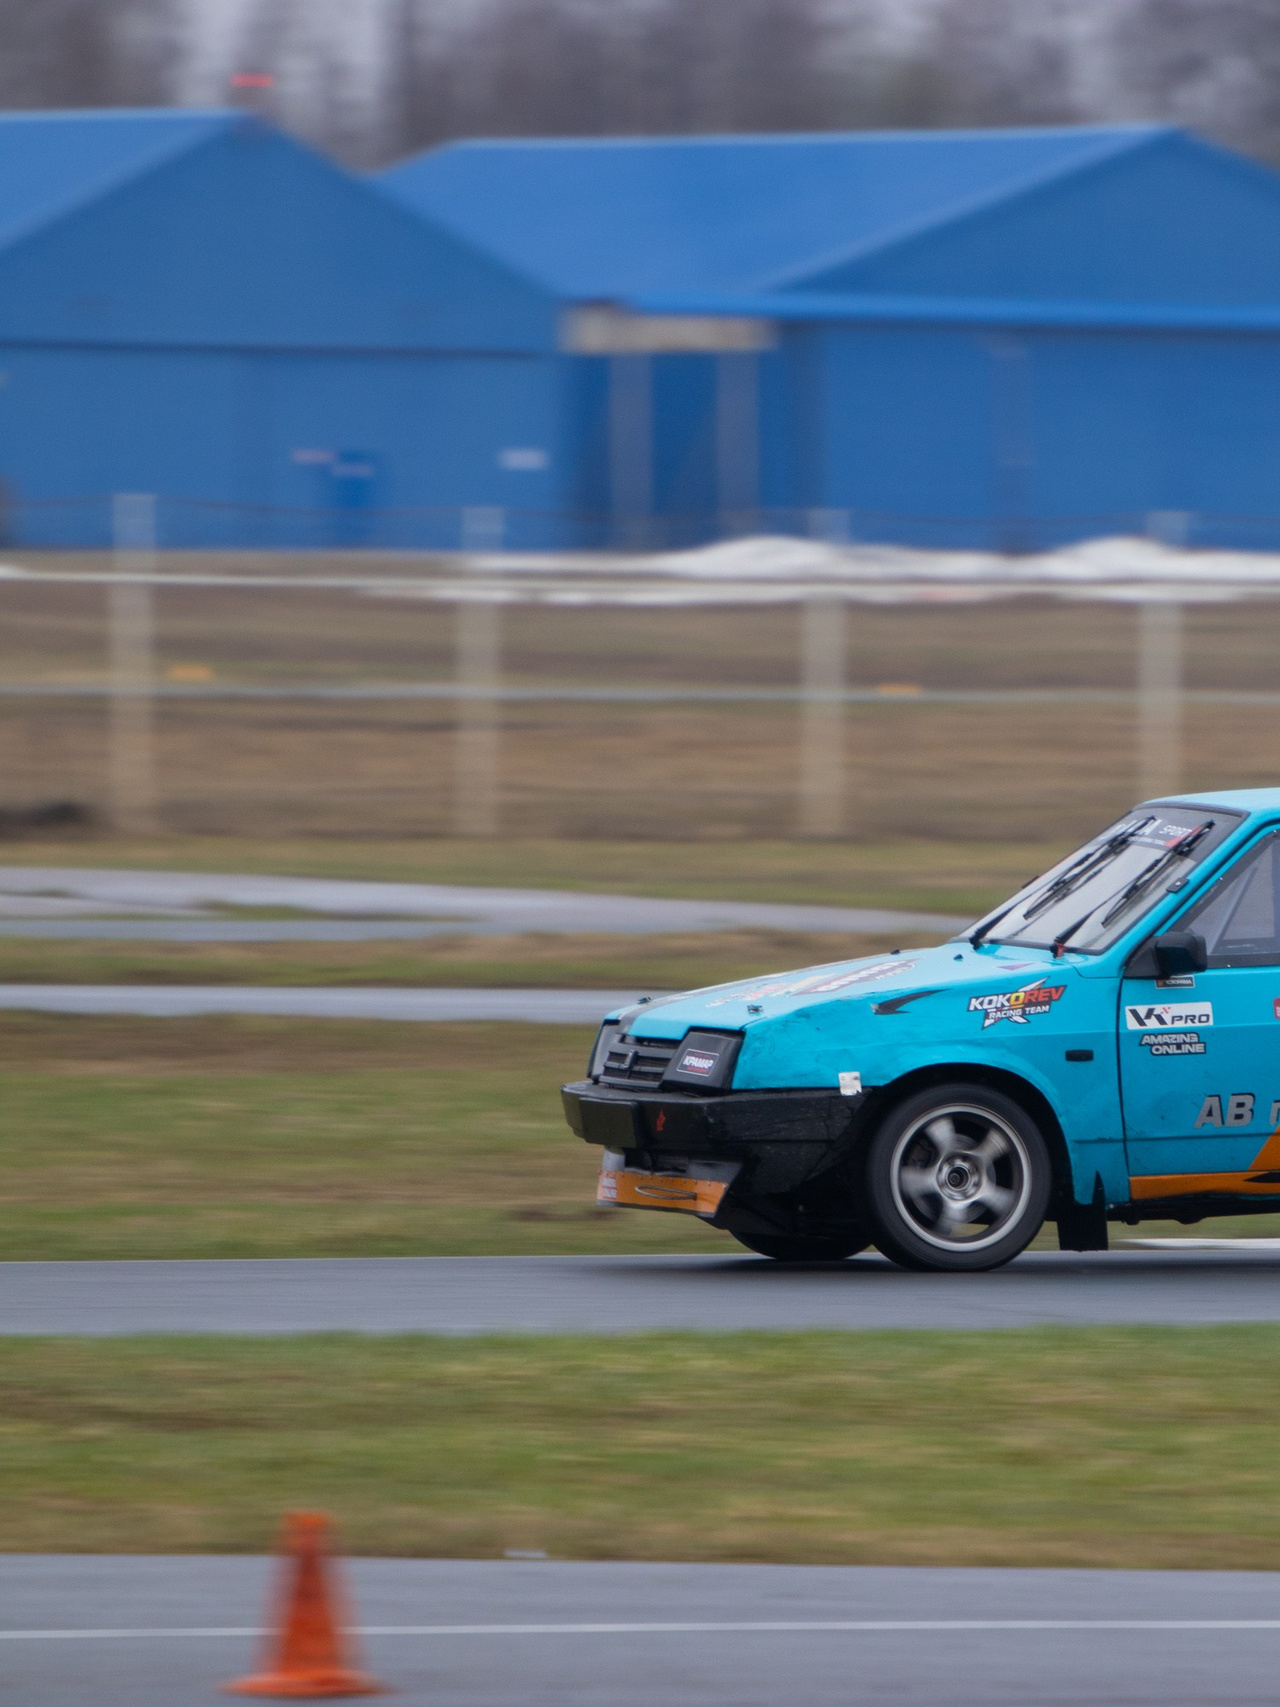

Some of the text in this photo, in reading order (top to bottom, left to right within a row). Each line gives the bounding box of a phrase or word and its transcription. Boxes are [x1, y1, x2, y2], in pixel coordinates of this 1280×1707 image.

[969, 986, 1065, 1011] KOKOREV
[989, 1005, 1050, 1019] RACING TEAM
[1171, 1013, 1210, 1025] PRO
[1141, 1033, 1198, 1044] AMAZING
[1151, 1043, 1205, 1055] ONLINE
[1194, 1093, 1255, 1128] АВ
